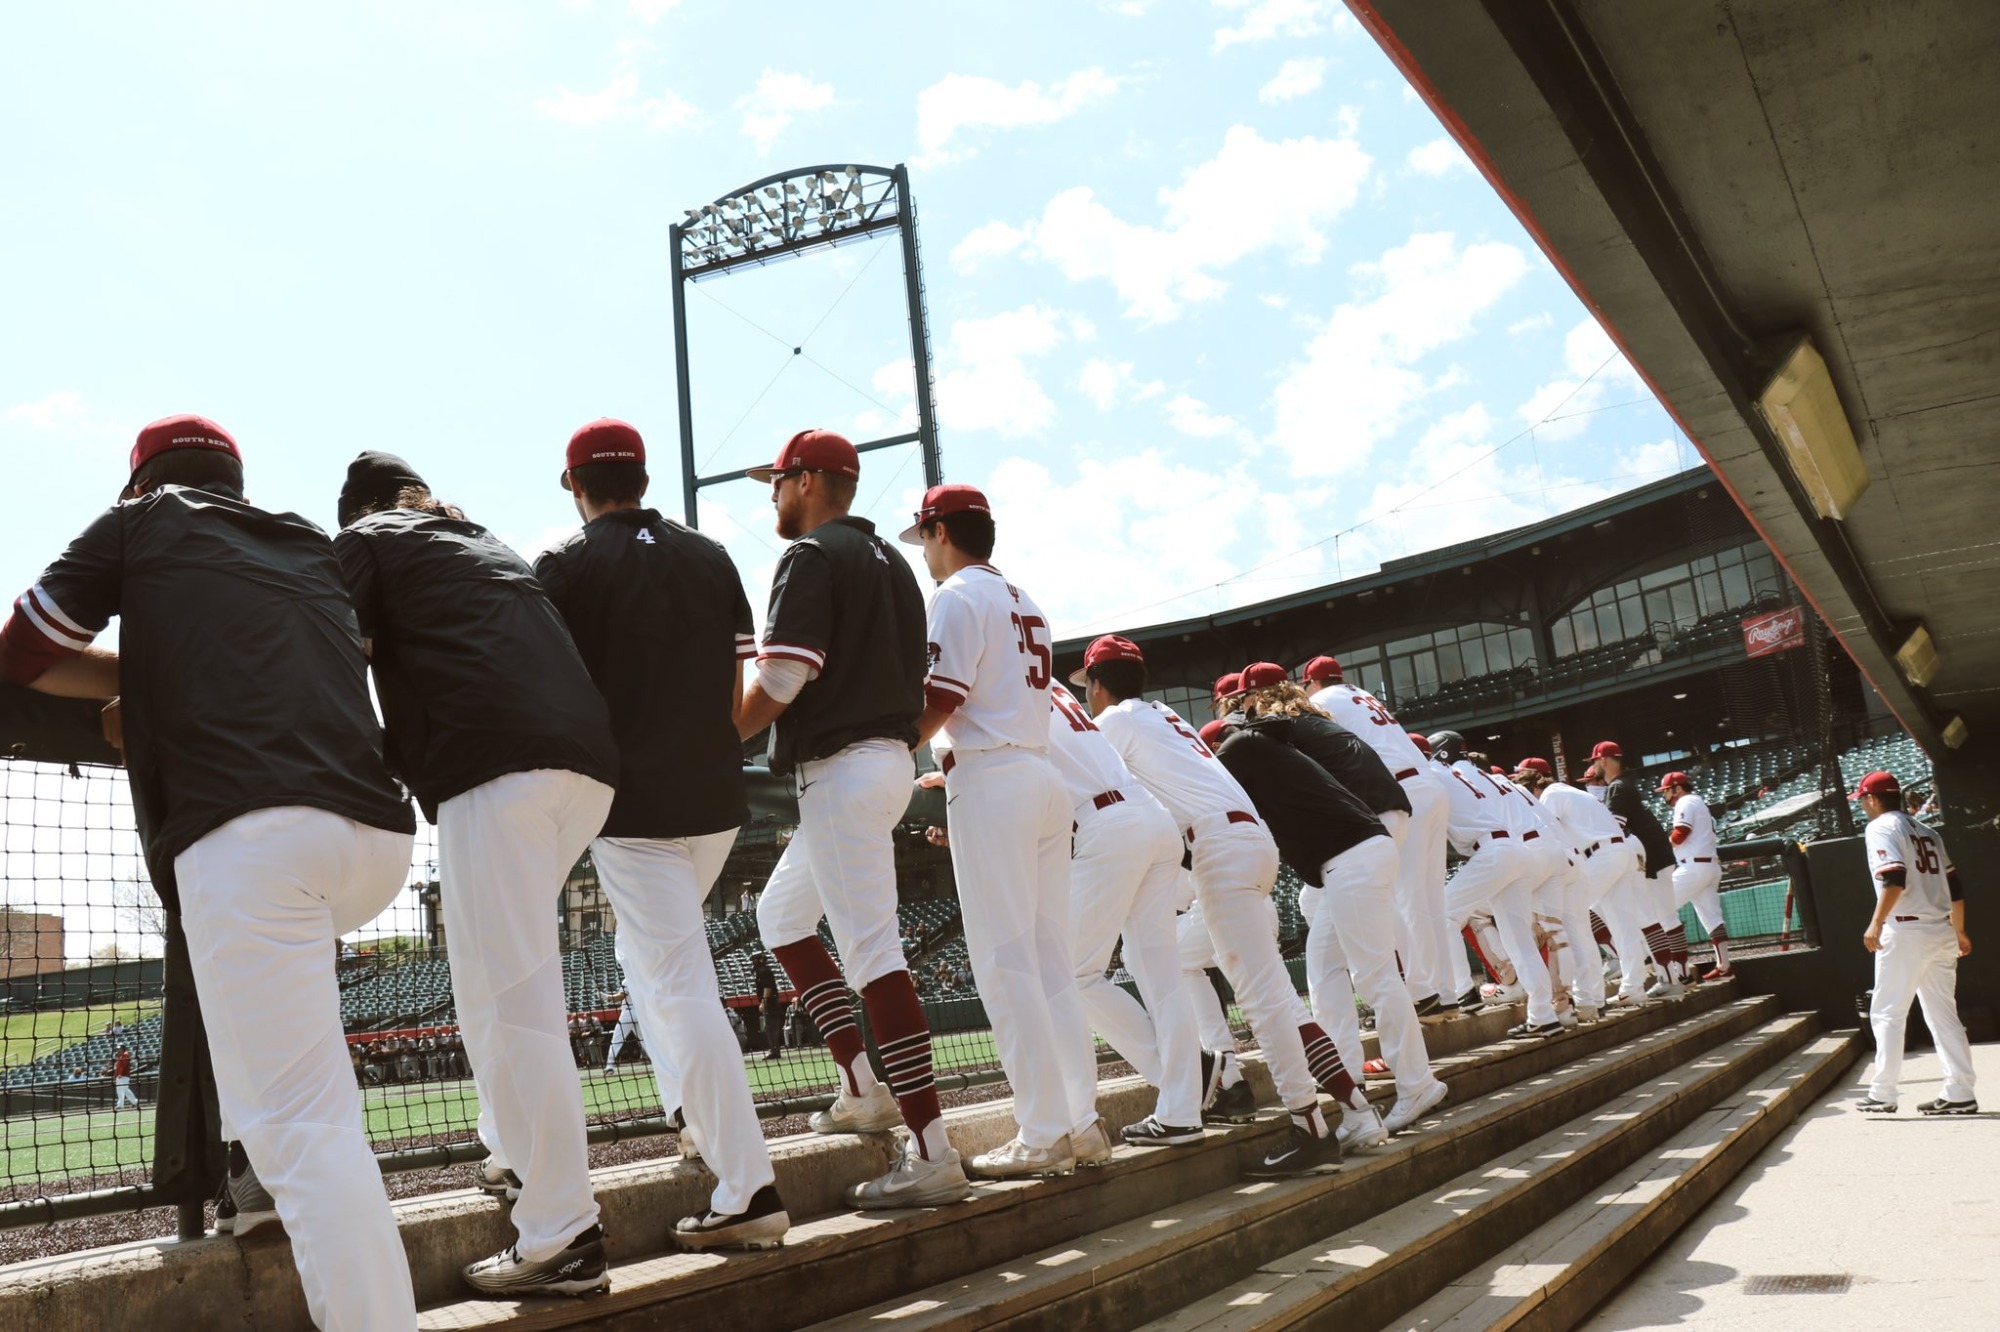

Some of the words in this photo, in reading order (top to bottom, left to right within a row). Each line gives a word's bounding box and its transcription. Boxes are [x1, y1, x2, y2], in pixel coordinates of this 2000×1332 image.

[636, 527, 656, 545] 4
[1909, 834, 1940, 875] 36
[558, 1258, 584, 1274] vapor
